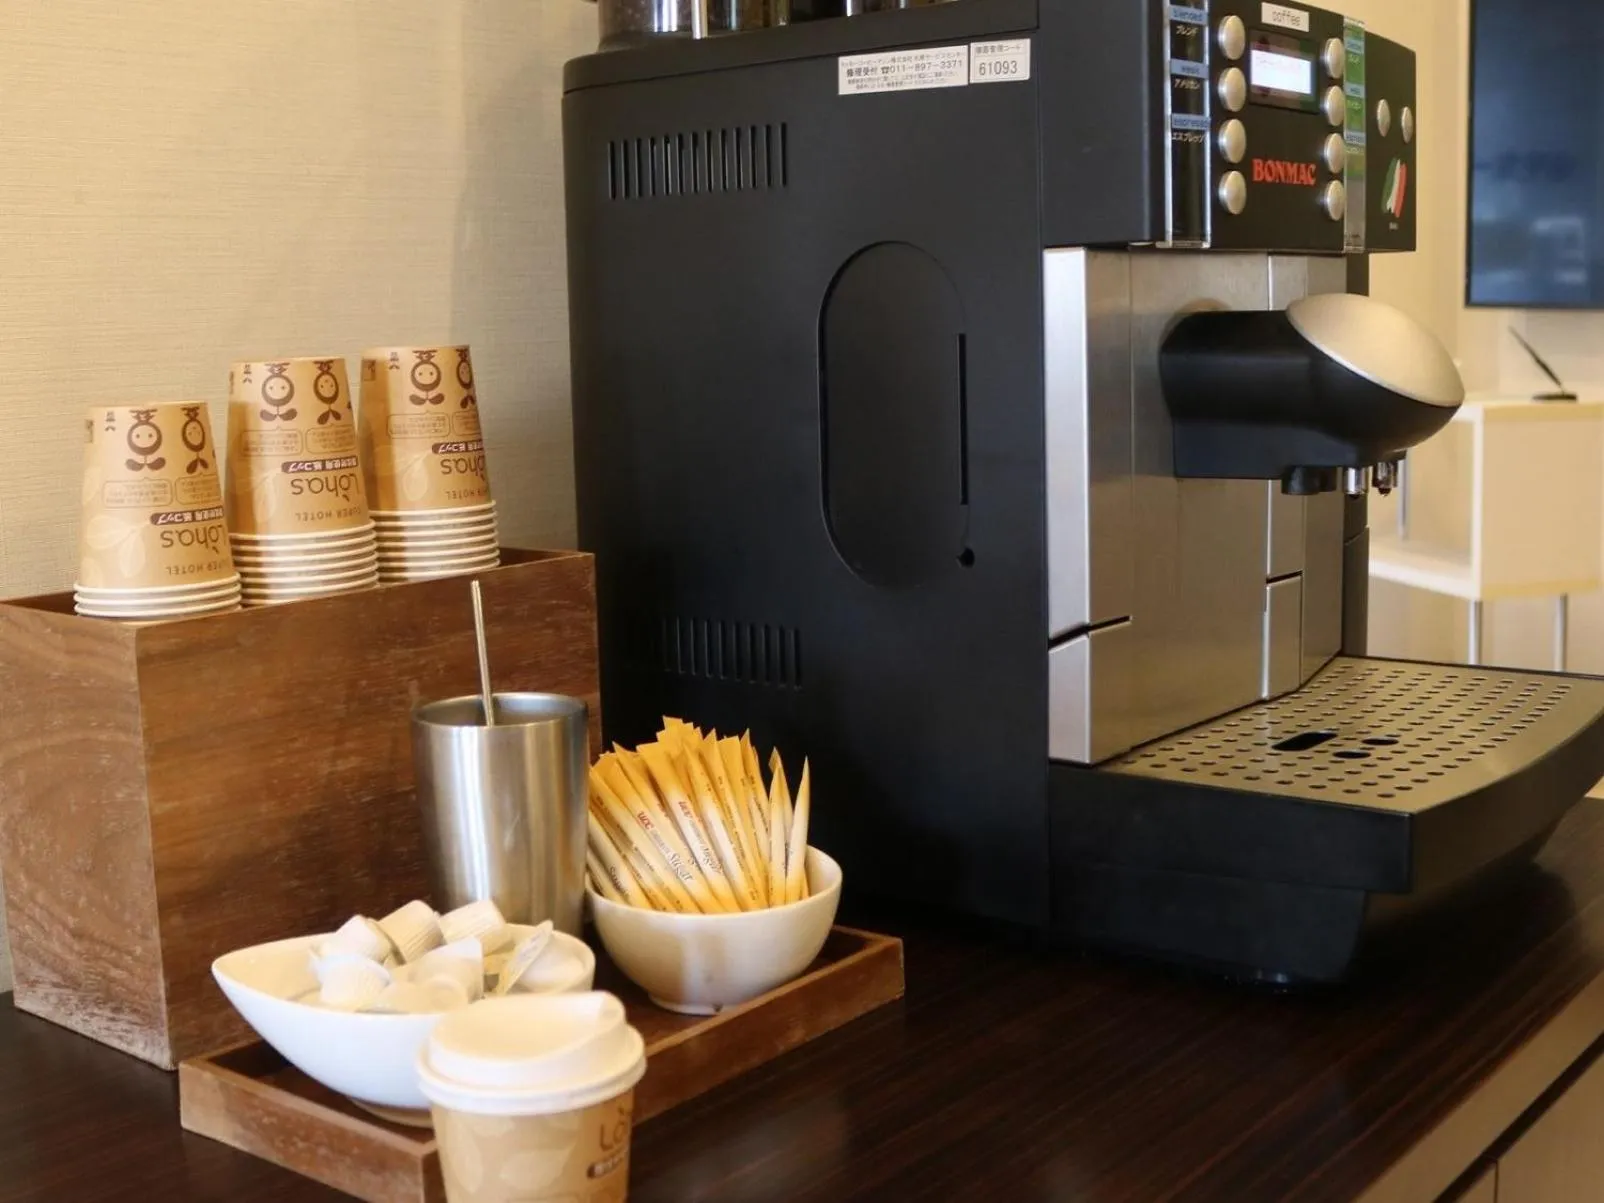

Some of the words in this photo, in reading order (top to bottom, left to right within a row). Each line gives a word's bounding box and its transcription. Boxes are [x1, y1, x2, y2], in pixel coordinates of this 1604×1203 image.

[1271, 9, 1302, 27] coffee
[979, 60, 1018, 75] 61093
[1252, 158, 1317, 186] BONMAC
[445, 488, 476, 500] HOTEL
[295, 510, 333, 521] HOTEL
[165, 563, 204, 575] HOTEL
